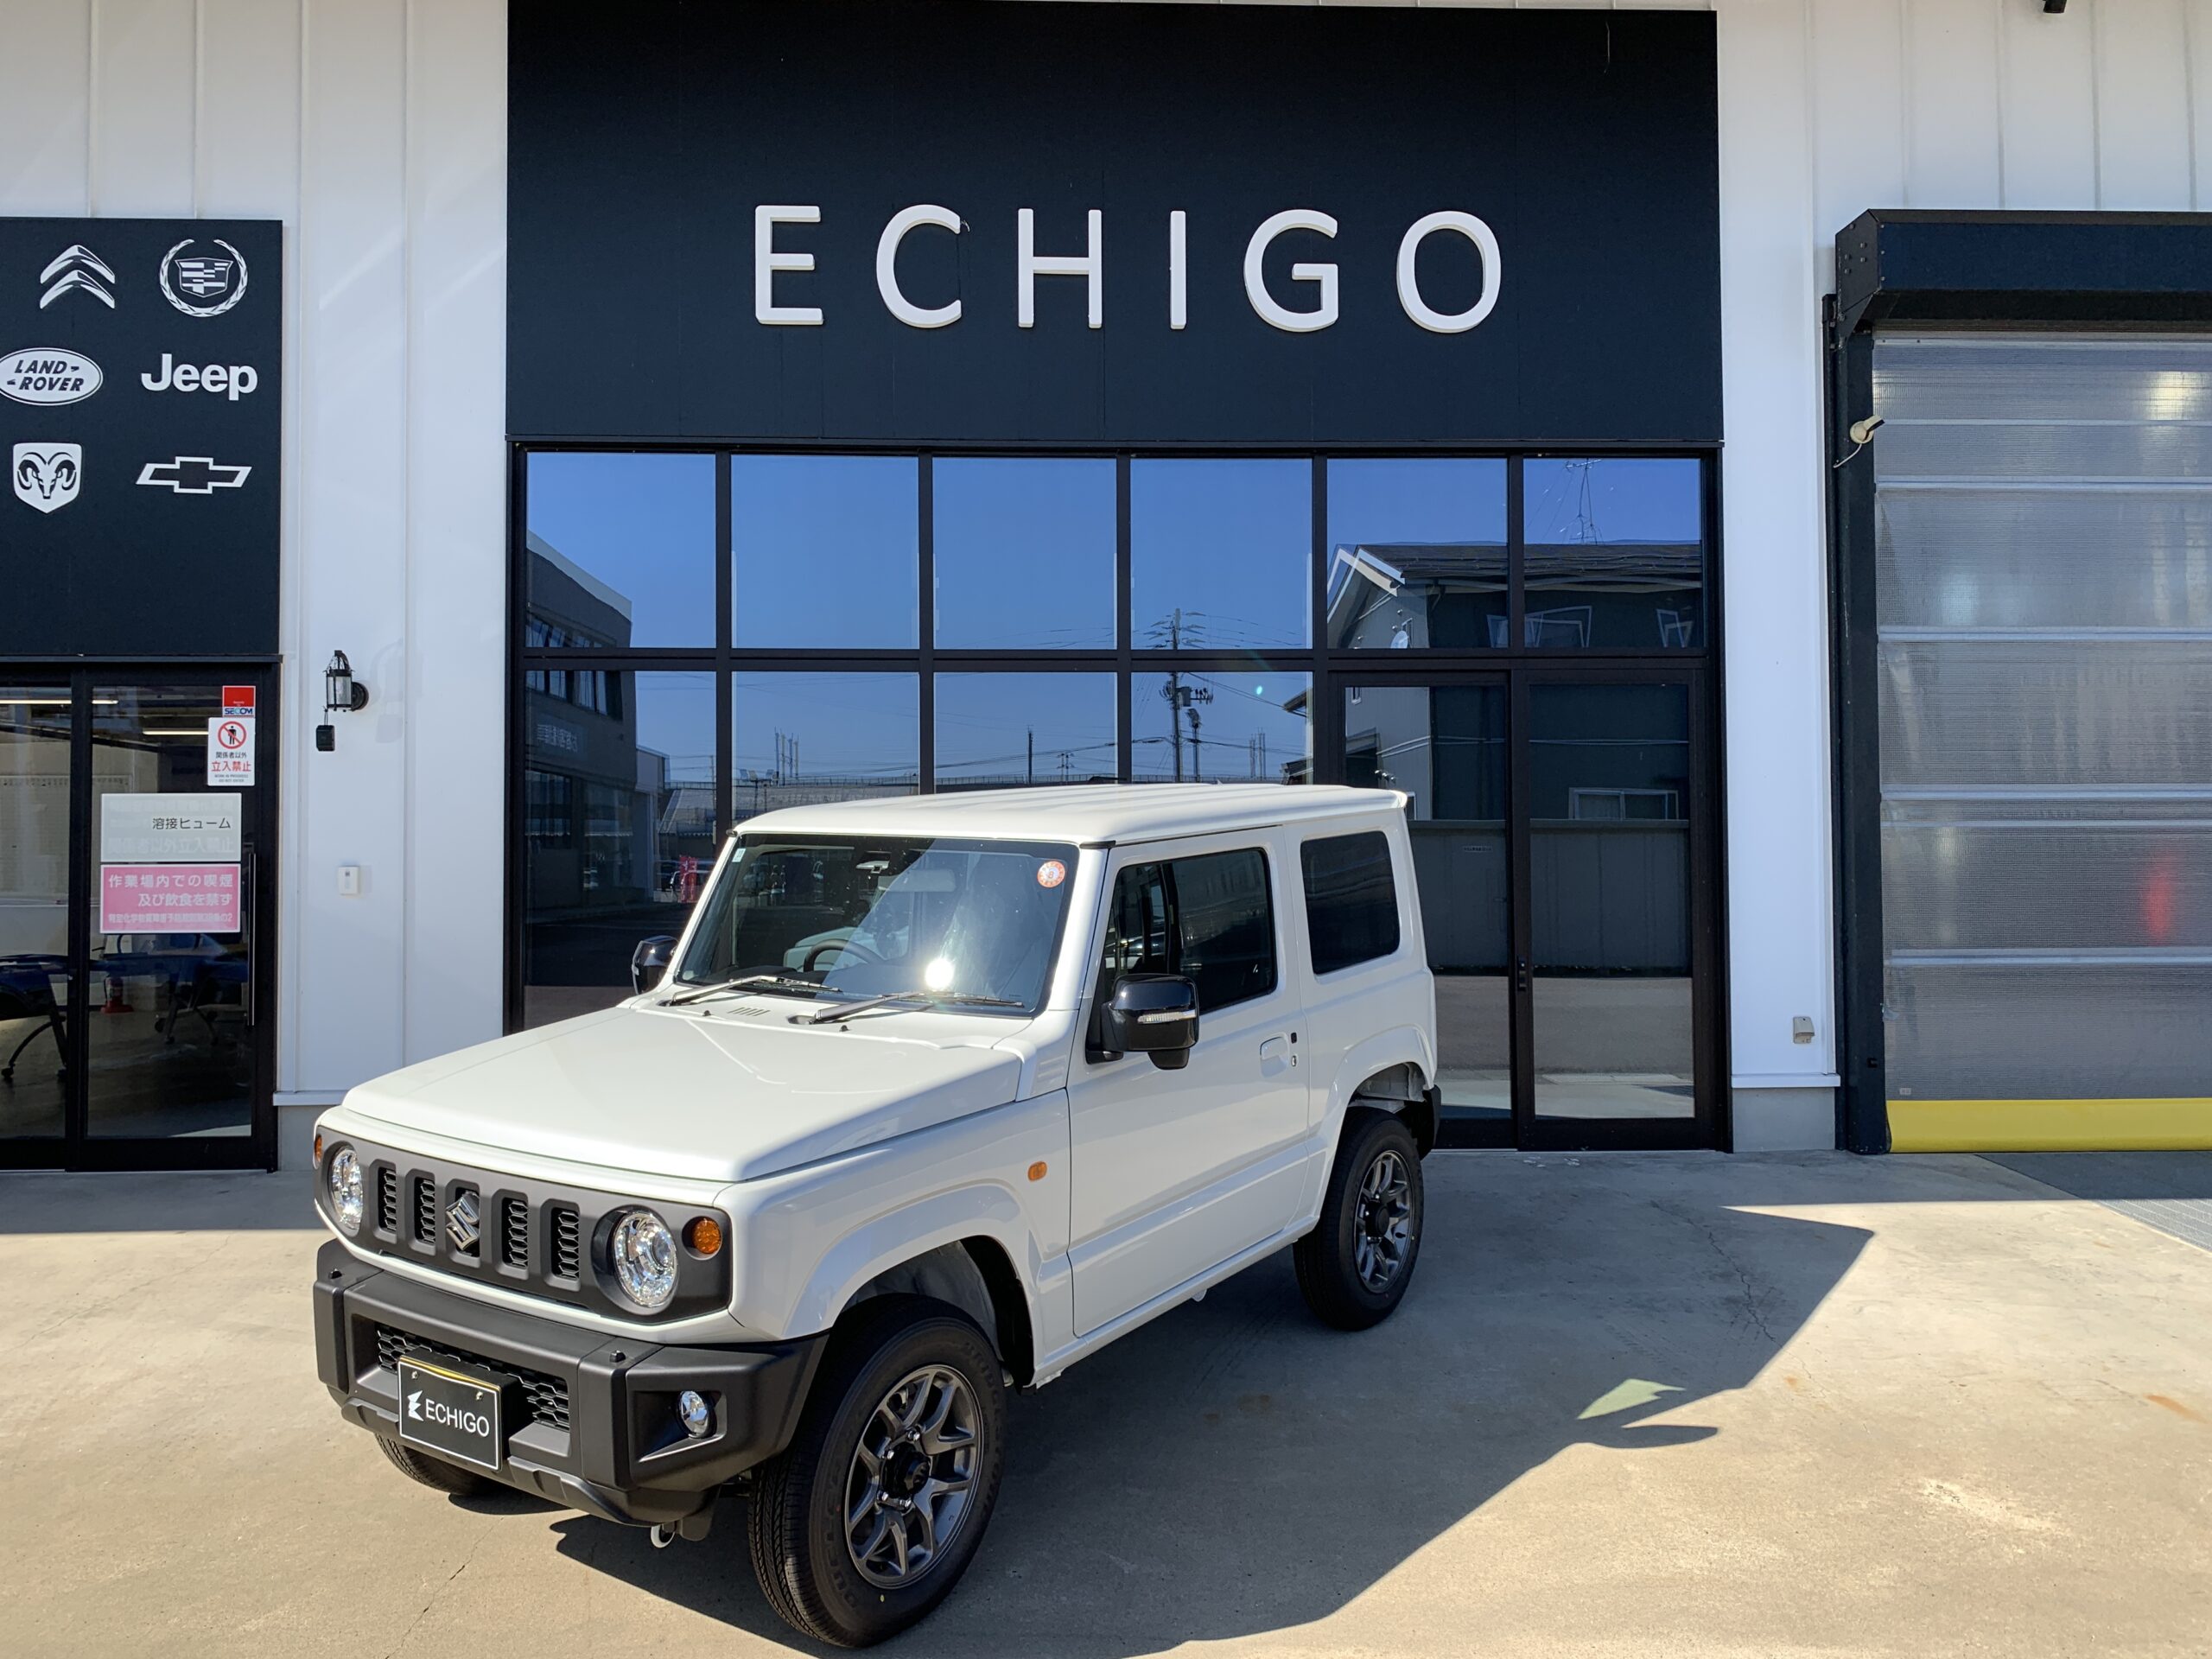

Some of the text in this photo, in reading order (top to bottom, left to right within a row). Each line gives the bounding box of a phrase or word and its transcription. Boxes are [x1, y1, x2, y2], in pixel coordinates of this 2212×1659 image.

[754, 205, 1502, 334] ECHIGO
[15, 359, 67, 375] LAND
[19, 377, 85, 392] ROVER
[141, 353, 258, 401] Jeep
[211, 760, 251, 772] 立入禁止
[151, 817, 232, 830] 溶接ヒューム
[109, 874, 233, 888] 作業場内での喫煙
[138, 893, 232, 907] 及び飲食を禁ず
[426, 1398, 490, 1437] ECHIGO
